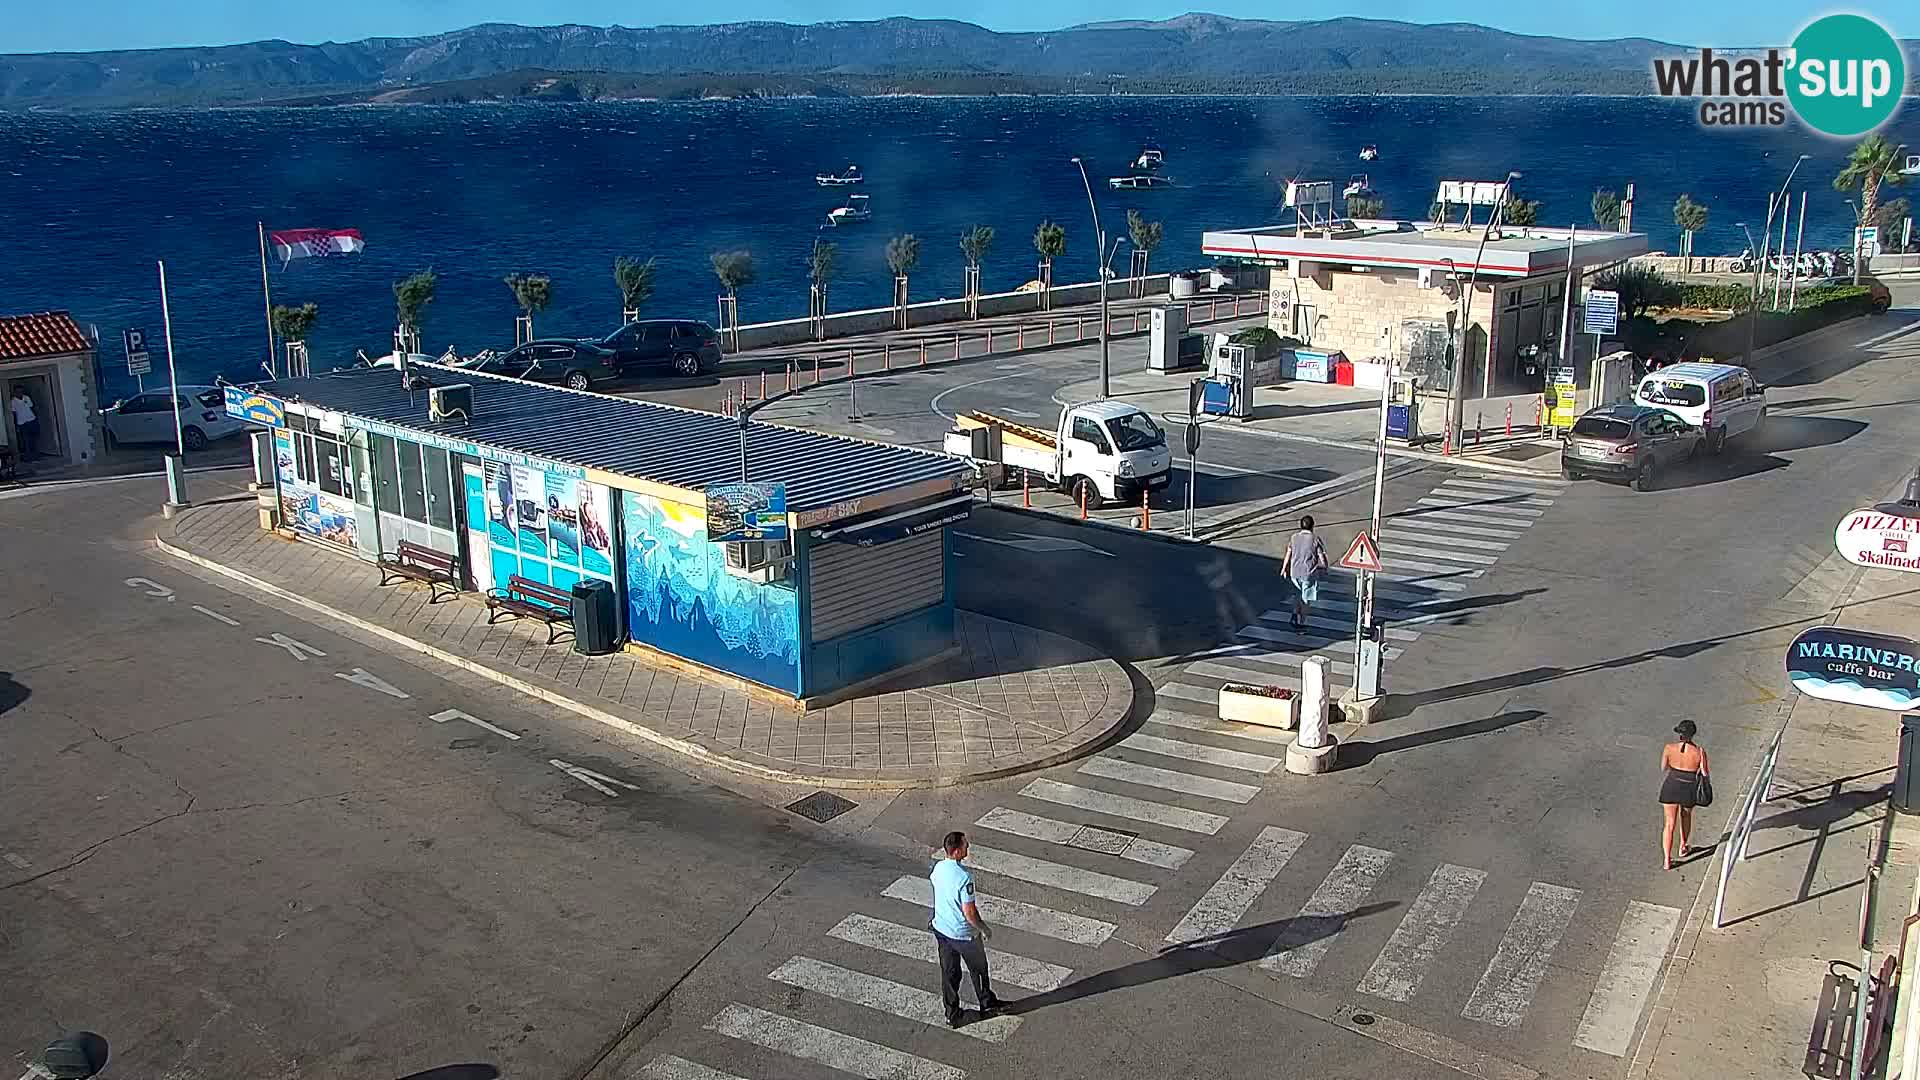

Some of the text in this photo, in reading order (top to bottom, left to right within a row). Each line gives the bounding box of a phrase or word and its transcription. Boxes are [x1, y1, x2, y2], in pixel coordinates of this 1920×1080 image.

[130, 332, 142, 350] P
[1665, 380, 1684, 390] TAXI
[493, 449, 525, 467] STATION
[555, 461, 582, 478] OFFICE
[1827, 661, 1896, 681] caffe bar
